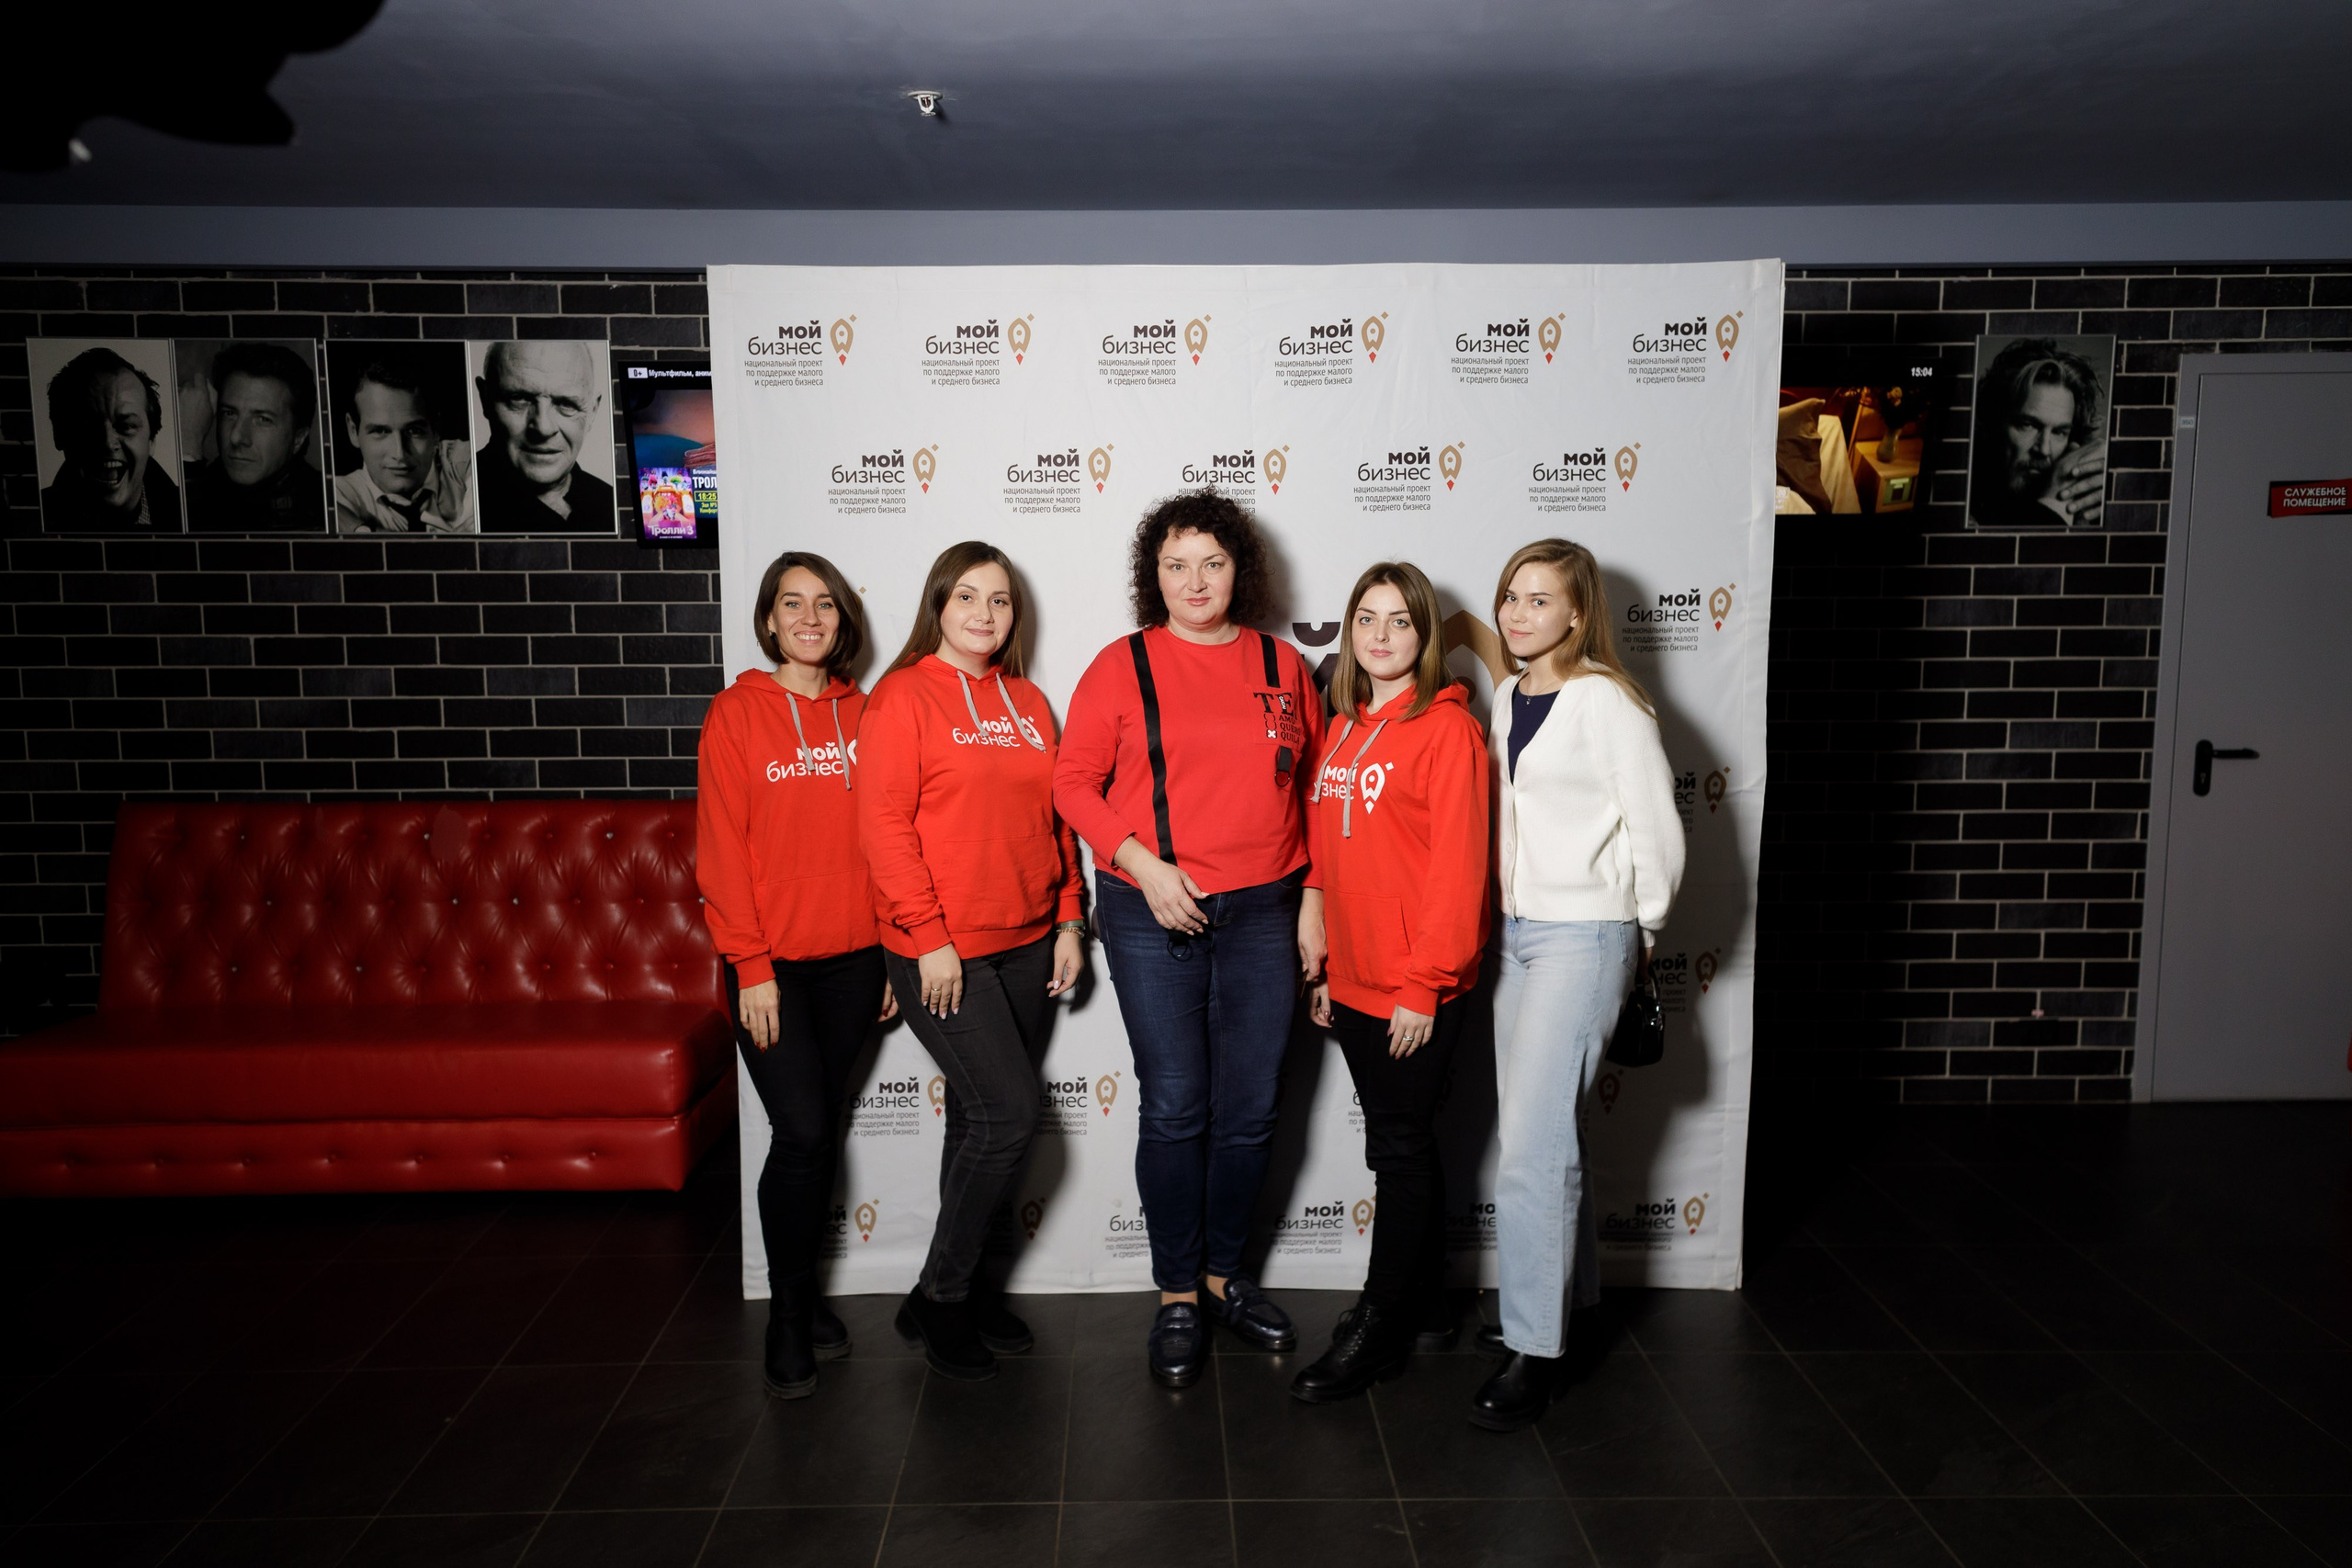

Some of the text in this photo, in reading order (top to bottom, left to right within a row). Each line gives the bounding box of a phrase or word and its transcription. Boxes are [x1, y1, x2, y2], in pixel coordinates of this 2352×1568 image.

[779, 320, 821, 339] мой
[956, 320, 999, 338] мой
[1134, 319, 1176, 338] мой
[1310, 319, 1353, 338] мой
[1487, 318, 1531, 337] мой
[1664, 317, 1708, 335] мой
[748, 336, 822, 355] бизнес
[926, 335, 1000, 355] бизнес
[1102, 334, 1176, 355] бизнес
[1279, 334, 1353, 355] бизнес
[1455, 333, 1530, 354] бизнес
[1633, 333, 1707, 353] бизнес
[744, 359, 822, 368] национальный проект
[922, 358, 1000, 367] национальный проект
[1098, 358, 1176, 367] национальный проект
[1274, 358, 1352, 368] национальный проект
[1451, 355, 1529, 367] национальный проект
[1627, 356, 1706, 366] национальный проект
[1286, 369, 1326, 378] поддержке
[1463, 367, 1501, 376] поддержке
[1911, 367, 1933, 378] 15:04
[972, 377, 1001, 385] бизнеса
[1114, 378, 1146, 387] среднего
[1148, 377, 1176, 385] бизнеса
[1290, 379, 1322, 388] среднего
[1325, 376, 1352, 384] бизнеса
[1466, 377, 1498, 385] среднего
[1500, 376, 1529, 384] бизнеса
[862, 449, 904, 468] мой
[1037, 448, 1080, 467] мой
[1213, 449, 1255, 468] мой
[1388, 446, 1430, 465] мой
[1564, 447, 1606, 466] мой
[831, 464, 905, 483] бизнес
[1007, 464, 1080, 482] бизнес
[1182, 464, 1256, 484] бизнес
[1358, 461, 1430, 481] бизнес
[1532, 462, 1606, 481] бизнес
[698, 492, 717, 501] 18:25
[828, 487, 879, 496] национальный
[1003, 487, 1080, 496] национальный проект
[1231, 488, 1256, 496] проект
[1353, 485, 1430, 493] национальный проект
[1529, 485, 1579, 493] национальный
[2284, 487, 2346, 497] СЛУЖЕБНОЕ
[1365, 495, 1404, 503] поддержке
[2283, 497, 2346, 507] ПОМЕЩЕНИЕ
[648, 525, 694, 536] Тролли 3
[1658, 588, 1702, 606] мой
[1627, 604, 1701, 622] бизнес
[1622, 626, 1699, 635] национальный проект
[980, 716, 1014, 734] мой
[952, 728, 1021, 747] бизнес
[796, 741, 841, 761] мой
[766, 760, 844, 783] бизнес
[1652, 953, 1687, 970] мой
[879, 1077, 919, 1093] мой
[1047, 1077, 1087, 1093] мой
[849, 1092, 920, 1109] бизнес
[892, 1127, 919, 1135] бизнеса
[1305, 1201, 1344, 1217] мой
[1470, 1203, 1495, 1213] мо
[1635, 1198, 1676, 1215] мой
[1274, 1214, 1343, 1230] бизнес
[1606, 1213, 1675, 1229] бизнес
